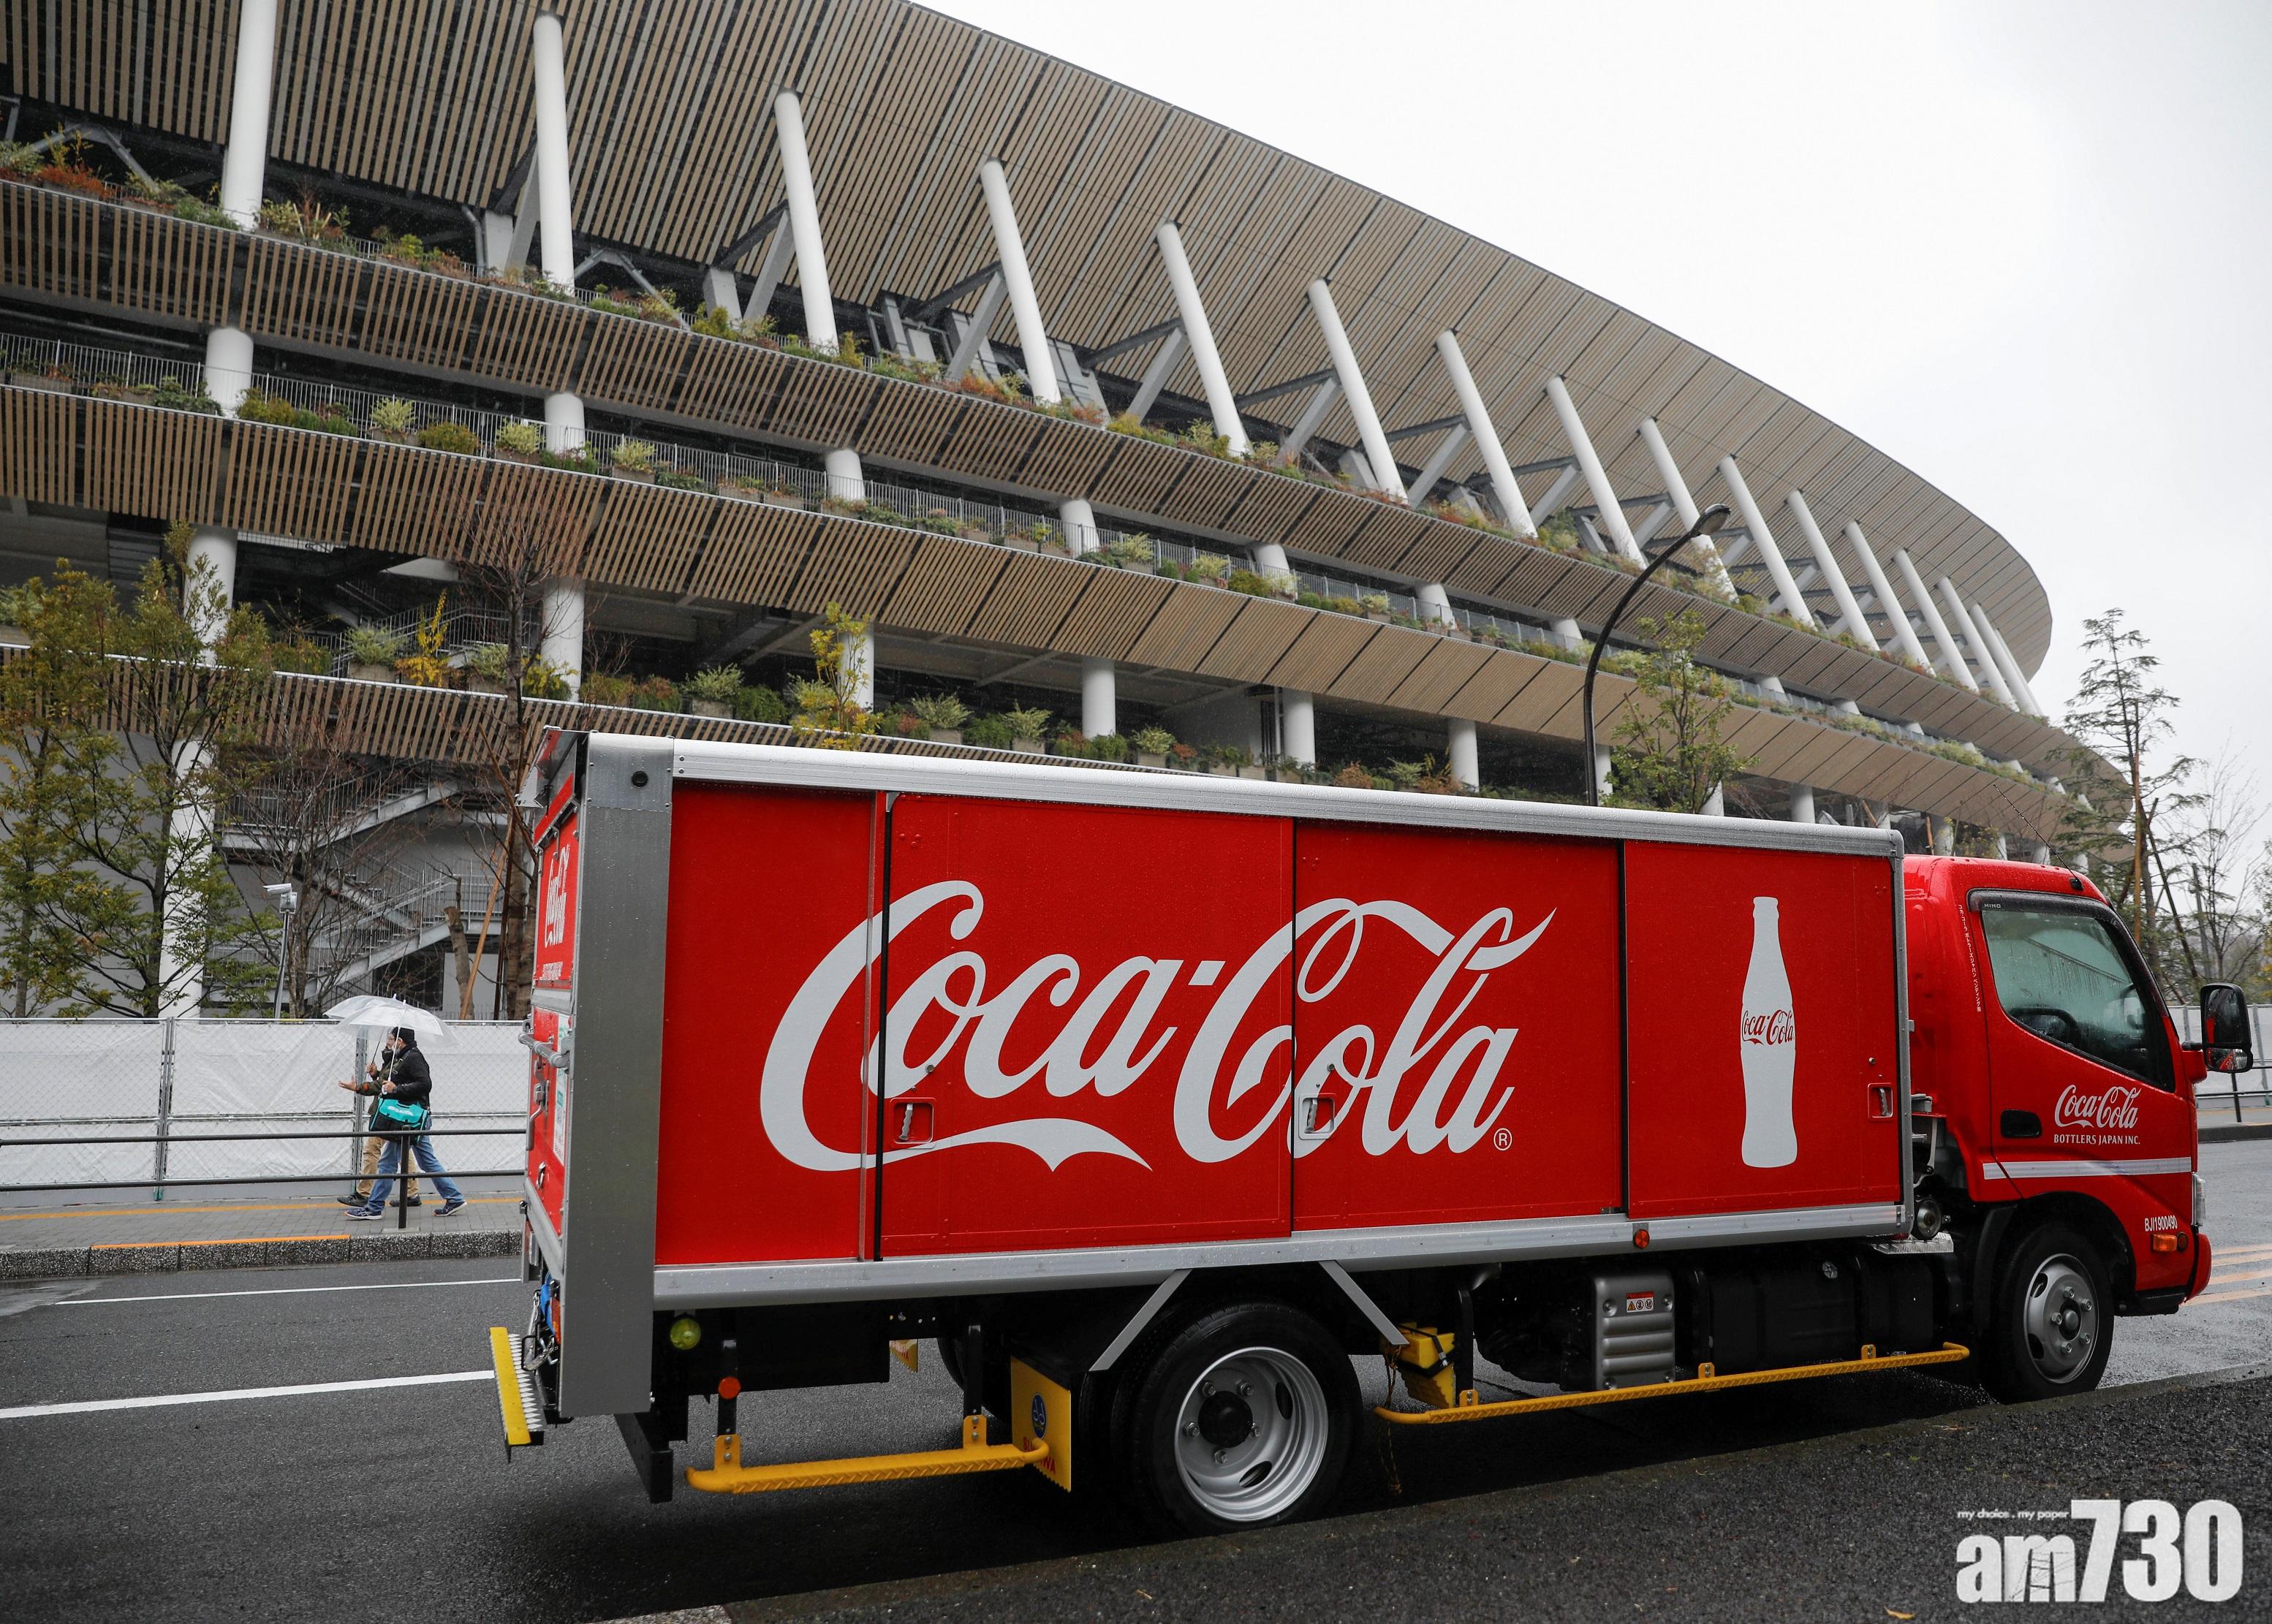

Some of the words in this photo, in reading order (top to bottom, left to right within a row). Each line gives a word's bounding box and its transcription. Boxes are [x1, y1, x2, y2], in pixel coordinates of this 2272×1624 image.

[760, 880, 1558, 1172] Coca-Cola
[1741, 1009, 1795, 1046] Coca-Cola
[2055, 1084, 2142, 1128] Coca-Cola
[2054, 1134, 2097, 1145] BOTTLERS
[2098, 1135, 2124, 1146] JAPAN
[2124, 1135, 2140, 1145] INC.
